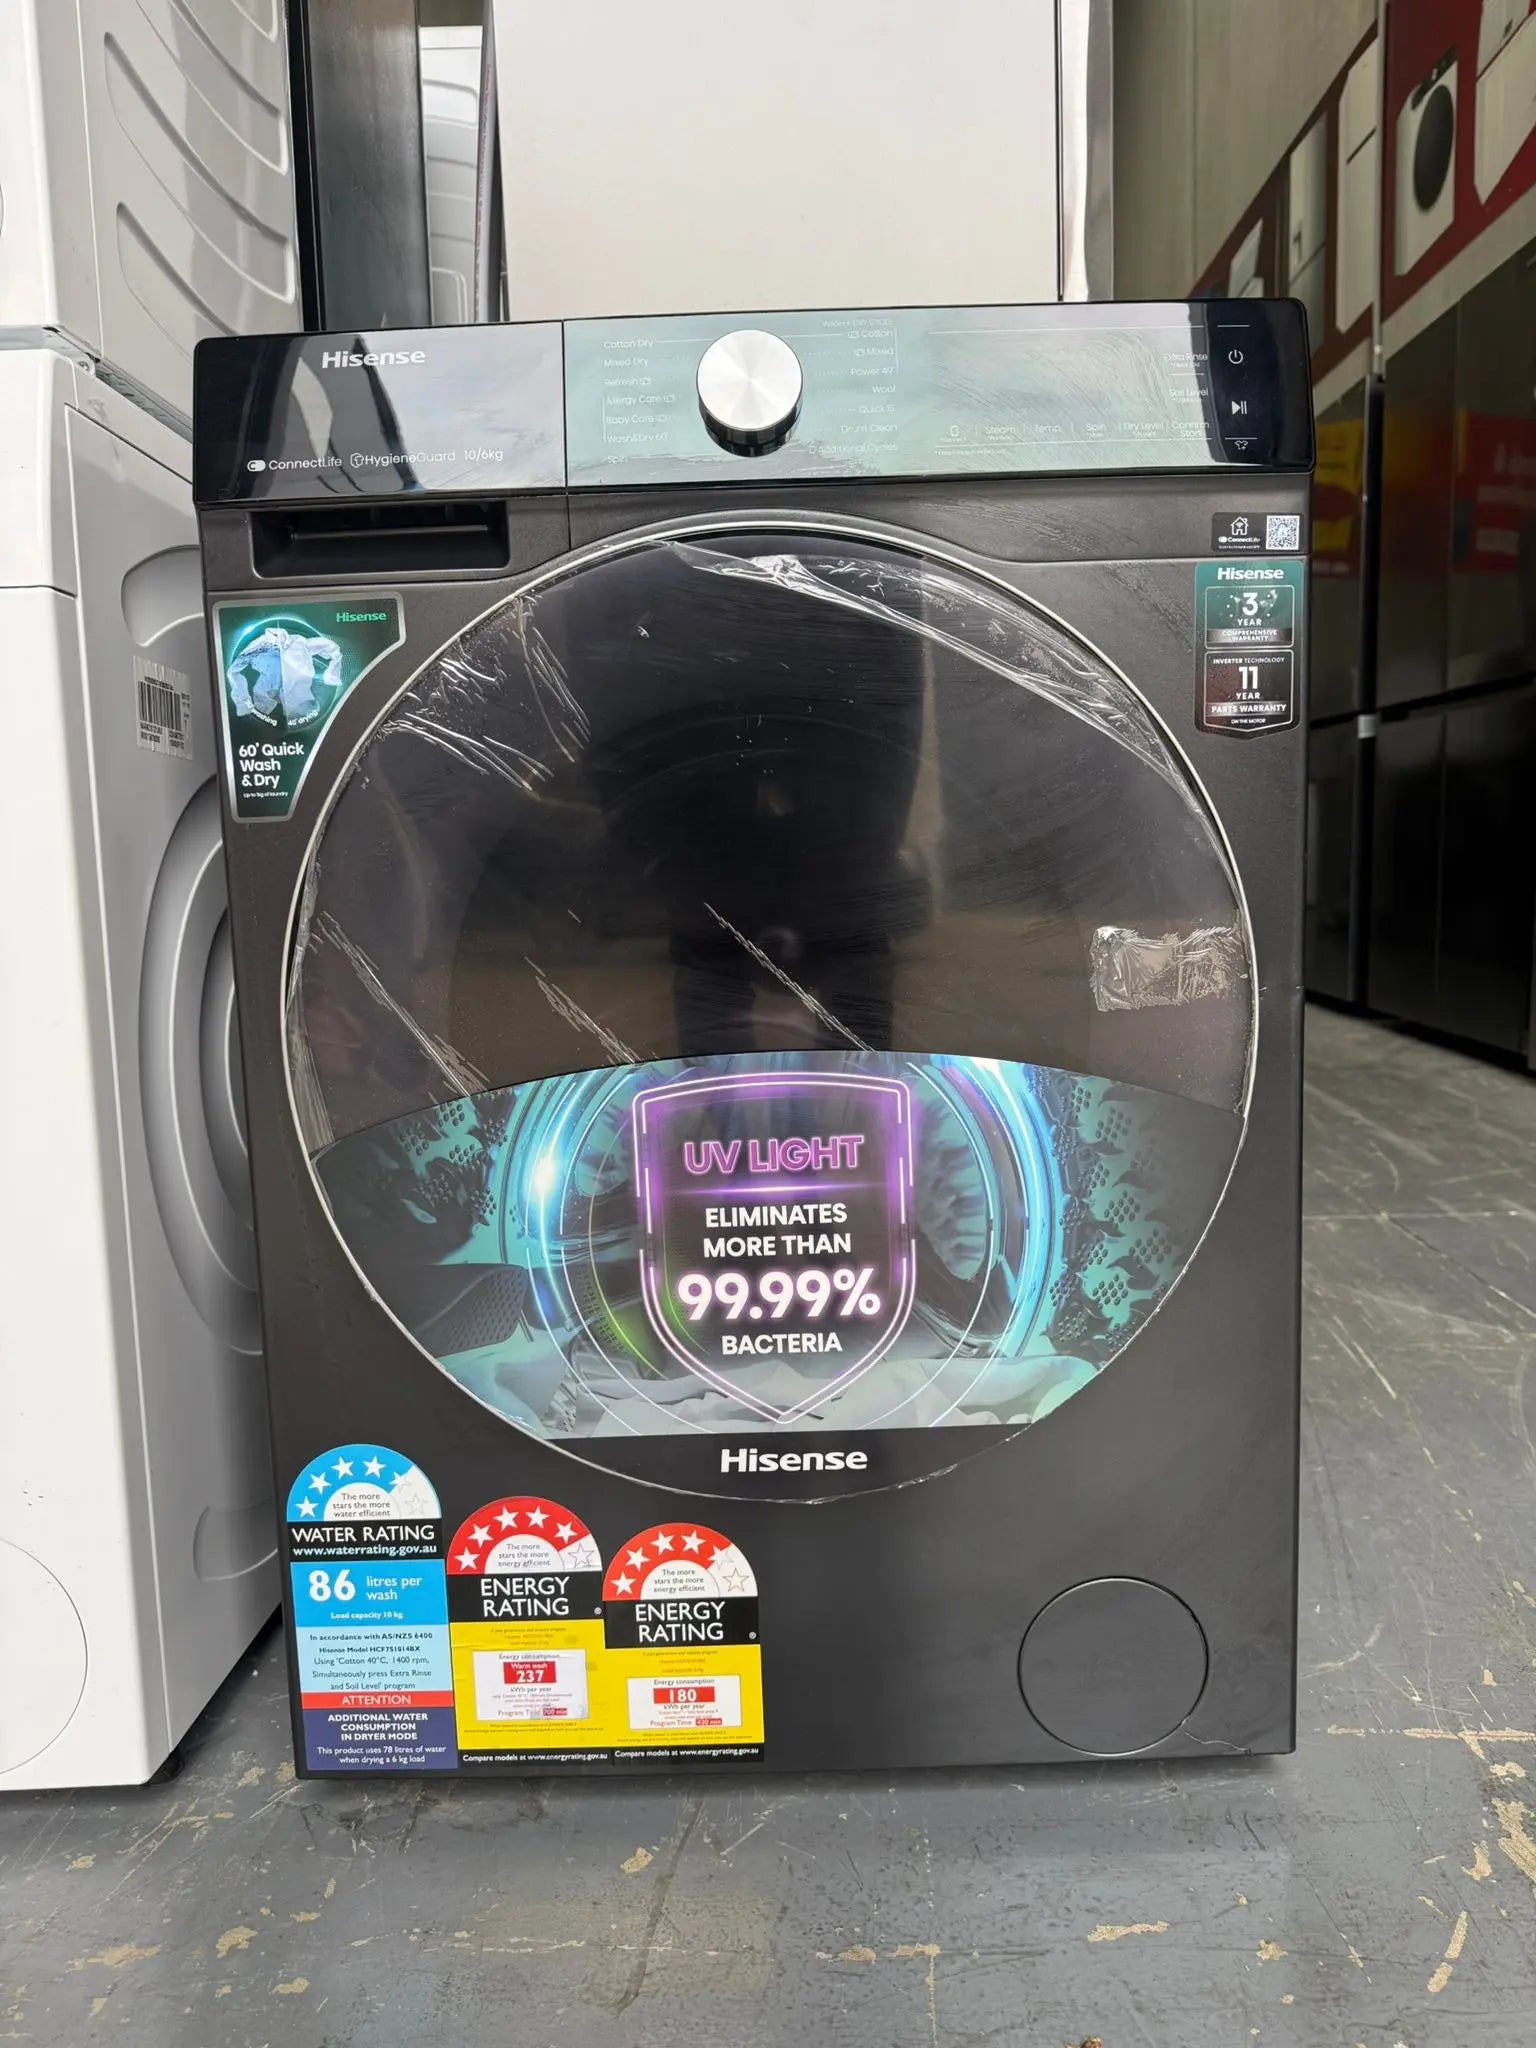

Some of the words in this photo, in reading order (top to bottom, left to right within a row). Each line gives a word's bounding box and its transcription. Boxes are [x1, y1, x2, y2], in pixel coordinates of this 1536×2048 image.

[861, 330, 894, 338] Cotton
[603, 340, 635, 349] Cotton
[637, 339, 653, 349] Dry
[322, 350, 426, 369] Hisense
[851, 367, 880, 376] Power
[872, 385, 896, 393] Wool
[607, 416, 630, 425] Baby
[840, 424, 867, 433] Drum
[1123, 423, 1140, 432] Dry
[269, 457, 343, 470] ConnectLife
[365, 450, 456, 467] HygieneGuard
[464, 449, 504, 463] 10/6kg
[1217, 567, 1284, 581] Hisense
[1242, 592, 1258, 616] 3
[336, 612, 387, 623] Hisense
[1237, 618, 1262, 626] YEAR
[1238, 666, 1258, 690] 11
[1236, 692, 1261, 700] YEAR
[1211, 705, 1238, 713] PARTS
[1239, 703, 1287, 713] WARRANTY
[261, 742, 305, 757] Quick
[239, 758, 281, 772] Wash
[241, 775, 252, 787] &
[254, 774, 280, 789] Dry
[683, 1140, 740, 1175] UV
[749, 1135, 865, 1173] LIGHT
[705, 1203, 848, 1228] ELIMINATES
[703, 1237, 776, 1259] MORE
[781, 1233, 852, 1255] THAN
[678, 1268, 881, 1321] 99.99%
[721, 1332, 843, 1355] BACTERIA
[720, 1448, 868, 1473] Hisense
[341, 1493, 358, 1501] The
[368, 1501, 390, 1509] more
[333, 1510, 356, 1518] water
[358, 1509, 391, 1517] efficient
[291, 1527, 357, 1543] WATER
[363, 1525, 435, 1542] RATING
[292, 1544, 437, 1557] www.waterrating.gov.au
[506, 1543, 520, 1551] The
[662, 1568, 676, 1576] The
[308, 1569, 356, 1601] 86
[366, 1576, 398, 1587] litres
[400, 1577, 423, 1589] per
[480, 1576, 570, 1597] ENERGY
[366, 1589, 398, 1600] wash
[483, 1597, 569, 1617] RATING
[635, 1601, 726, 1622] ENERGY
[331, 1611, 350, 1619] Load
[351, 1612, 382, 1620] capacity
[394, 1611, 404, 1620] kg
[638, 1622, 724, 1643] RATING
[314, 1658, 335, 1666] Using
[312, 1670, 366, 1679] Simultaneously
[368, 1671, 388, 1679] press
[411, 1669, 432, 1677] Rinse
[516, 1670, 545, 1683] 237
[345, 1682, 359, 1690] Soil
[384, 1683, 416, 1691] program
[341, 1695, 411, 1705] ATTENTION
[669, 1688, 697, 1703] 180
[327, 1713, 390, 1722] ADDITIONAL
[392, 1713, 429, 1721] WATER
[498, 1709, 524, 1718] Program
[341, 1723, 416, 1731] CONSUMPTION
[650, 1719, 676, 1727] Program
[341, 1733, 352, 1741] IN
[354, 1732, 386, 1741] DRYER
[388, 1732, 418, 1740] MODE
[317, 1746, 333, 1754] This
[334, 1746, 364, 1757] product
[394, 1745, 414, 1753] litres
[415, 1745, 424, 1753] of
[614, 1750, 645, 1758] Compare
[646, 1749, 669, 1757] models
[671, 1749, 678, 1757] at
[679, 1747, 759, 1758] www.energyrating.gov.au
[361, 1756, 385, 1766] drying
[398, 1755, 408, 1765] kg
[409, 1755, 425, 1763] load
[462, 1754, 494, 1762] Compare
[494, 1753, 518, 1761] models
[527, 1752, 608, 1762] www.energyrating.gov.au
